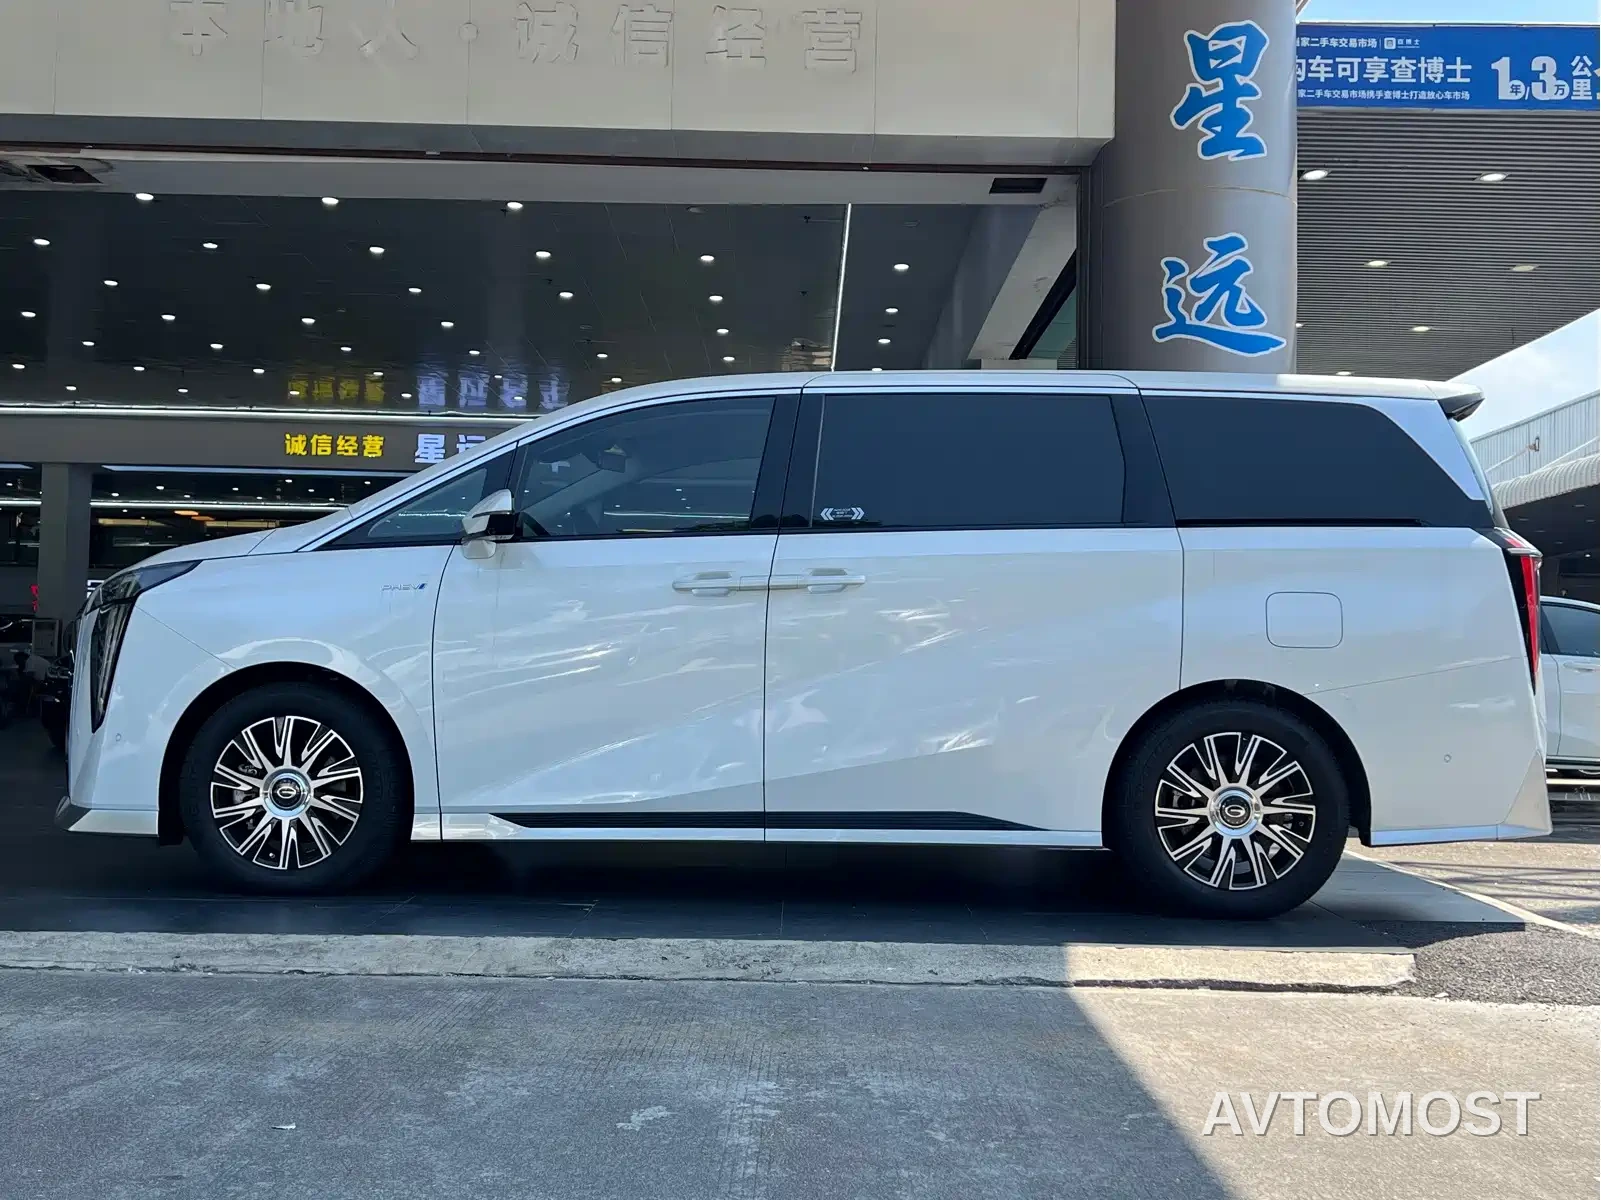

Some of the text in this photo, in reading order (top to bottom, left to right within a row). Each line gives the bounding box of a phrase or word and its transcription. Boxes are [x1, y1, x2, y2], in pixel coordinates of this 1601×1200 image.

[1152, 20, 1287, 358] 星远
[284, 433, 385, 458] 诚信经营
